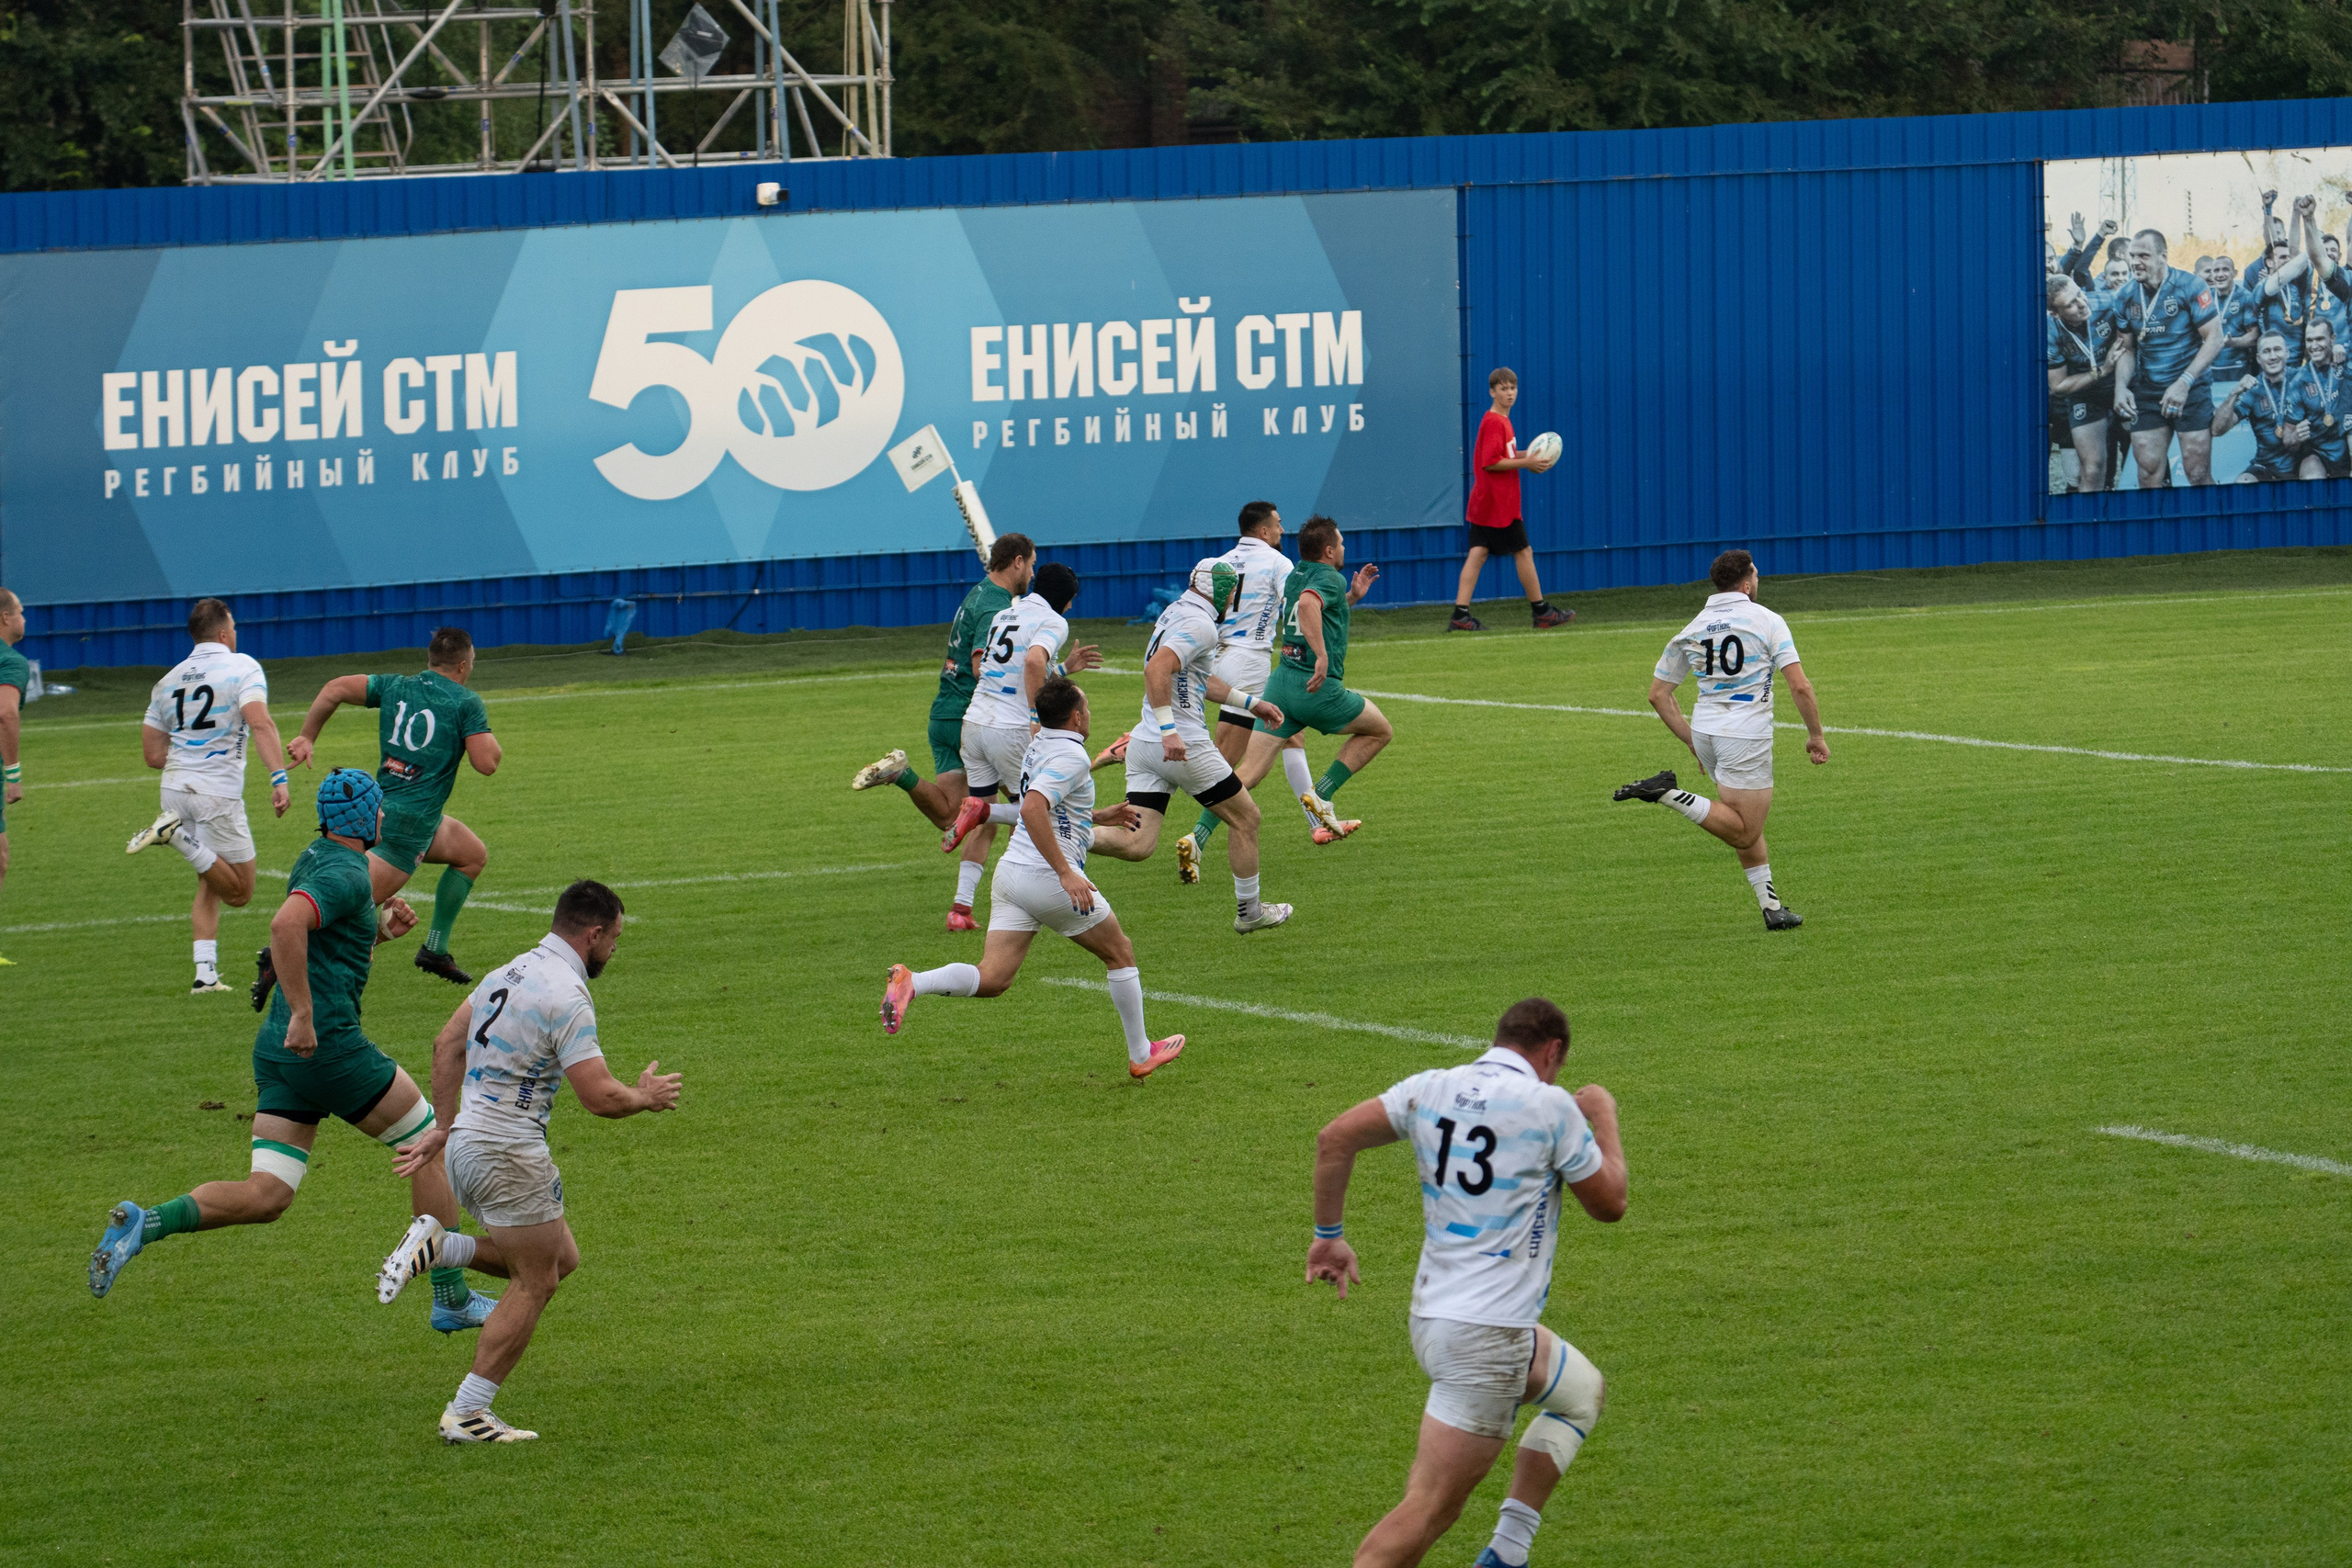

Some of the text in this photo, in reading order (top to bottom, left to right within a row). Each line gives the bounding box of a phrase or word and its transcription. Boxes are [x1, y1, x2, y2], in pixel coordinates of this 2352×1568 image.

[970, 296, 1364, 401] ЕНИСЕЙ СТМ
[103, 339, 518, 450] ЕНИСЕЙ СТМ
[588, 278, 905, 501] 50
[972, 402, 1365, 449] РЕГБИЙНЫЙ КЛУБ
[105, 446, 520, 499] РЕГБИЙНЫЙ КЛУБ
[983, 625, 1020, 663] 15
[1701, 635, 1744, 676] 10
[172, 684, 216, 730] 12
[388, 700, 435, 751] 10
[474, 987, 508, 1048] 2
[1435, 1116, 1497, 1196] 13
